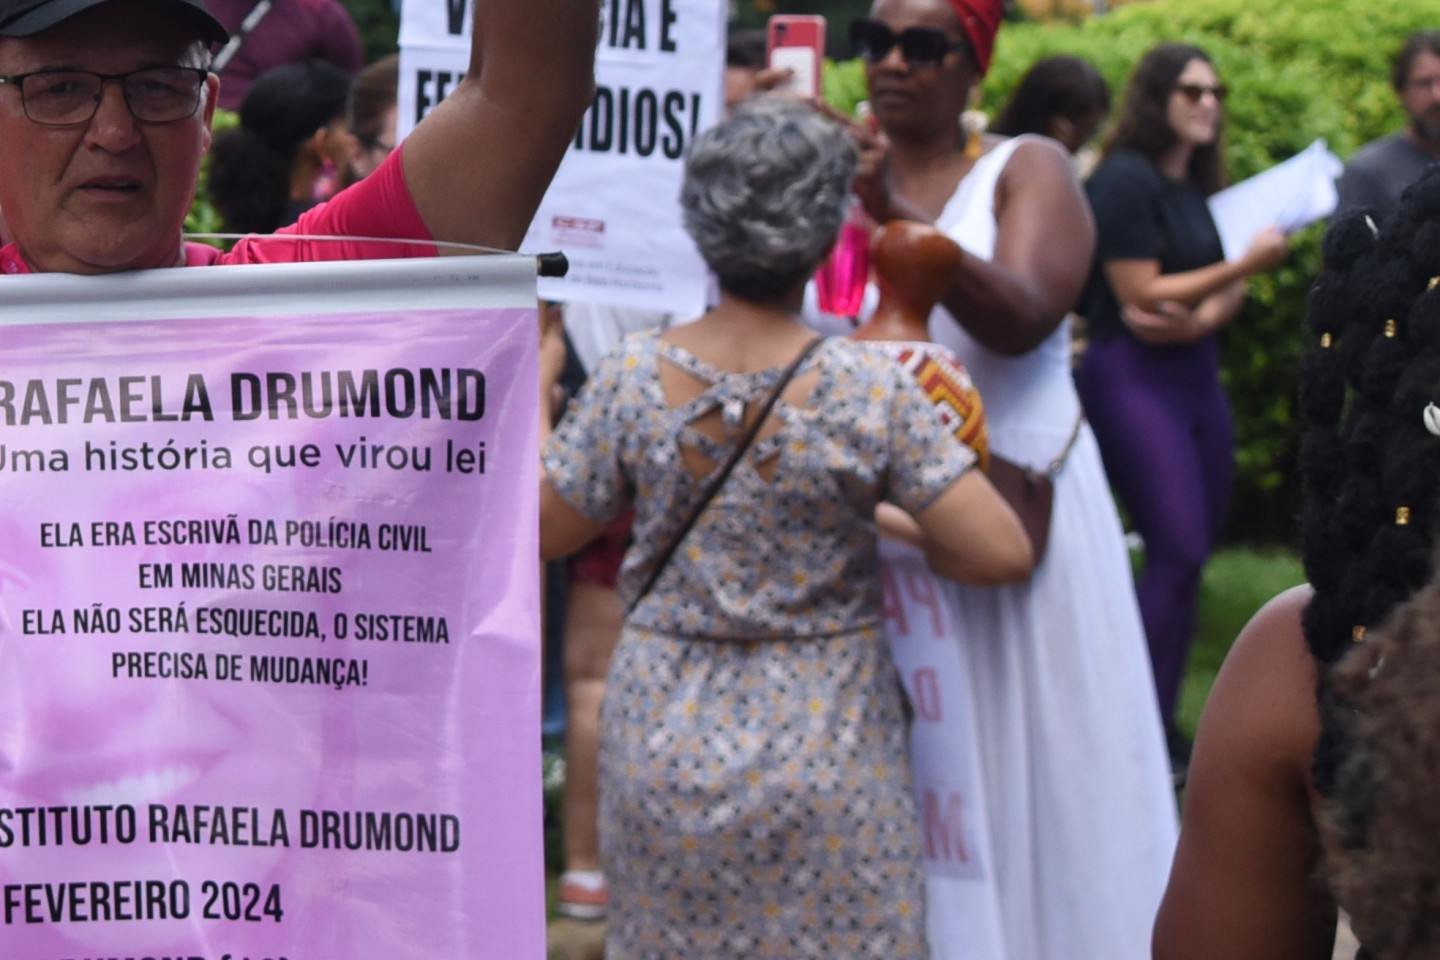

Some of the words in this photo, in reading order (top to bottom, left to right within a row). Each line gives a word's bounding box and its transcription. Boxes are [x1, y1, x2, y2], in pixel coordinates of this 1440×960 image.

[230, 368, 486, 422] DRUMOND
[85, 439, 232, 471] história
[248, 444, 321, 474] que
[335, 436, 431, 471] virou
[447, 439, 485, 474] lei
[41, 522, 84, 548] ELA
[91, 521, 136, 546] ERA
[144, 514, 241, 545] ESCRIVÃ
[248, 519, 278, 545] DA
[286, 516, 371, 549] POLÍCIA
[378, 524, 432, 552] CIVIL
[139, 563, 173, 589] EM
[181, 562, 255, 590] MINAS
[263, 564, 342, 594] GERAIS
[22, 609, 66, 635] ELA
[73, 603, 121, 634] NÃO
[128, 601, 189, 633] SERÁ
[196, 607, 326, 642] ESQUECIDA,
[334, 613, 347, 640] O
[354, 613, 449, 644] SISTEMA
[112, 652, 208, 680] PRECISA
[215, 653, 243, 681] DE
[250, 655, 367, 690] MUDANÇA!
[148, 804, 290, 848] RAFAELA
[300, 809, 460, 853] DRUMOND
[4, 879, 190, 924] FEVEREIRO
[201, 880, 284, 923] 2024
